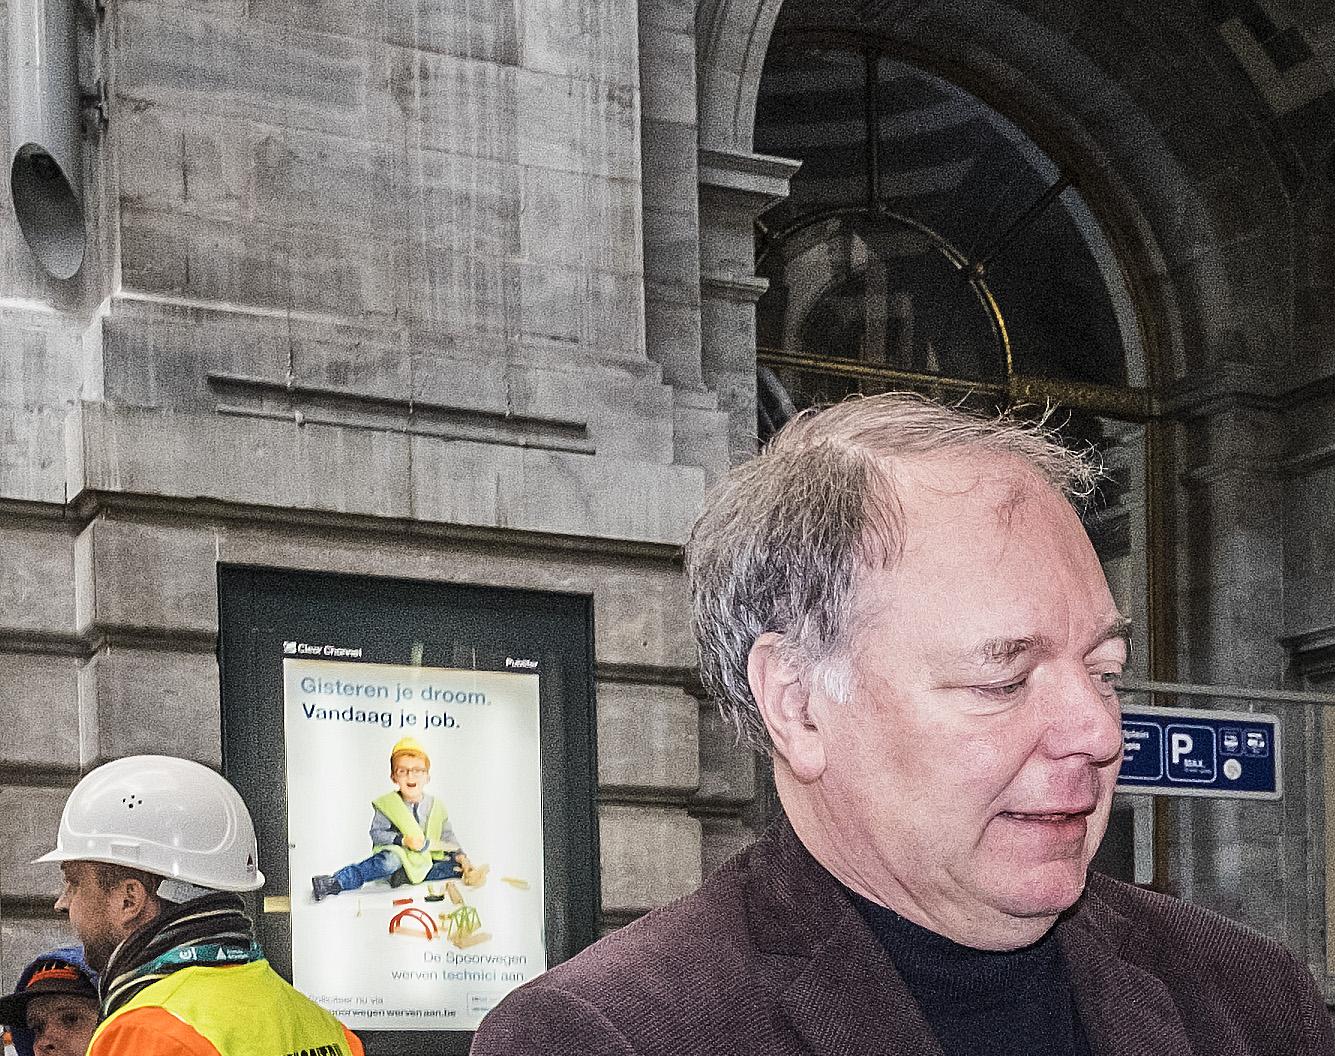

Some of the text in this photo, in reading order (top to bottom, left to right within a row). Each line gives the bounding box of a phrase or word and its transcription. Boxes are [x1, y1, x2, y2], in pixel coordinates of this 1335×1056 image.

[301, 677, 492, 705] Gisteren je droom.
[302, 703, 460, 729] Vandaag je job.
[1171, 733, 1193, 764] P
[424, 951, 527, 966] De Spoorwegen
[391, 970, 438, 981] werven
[442, 970, 497, 982] technici
